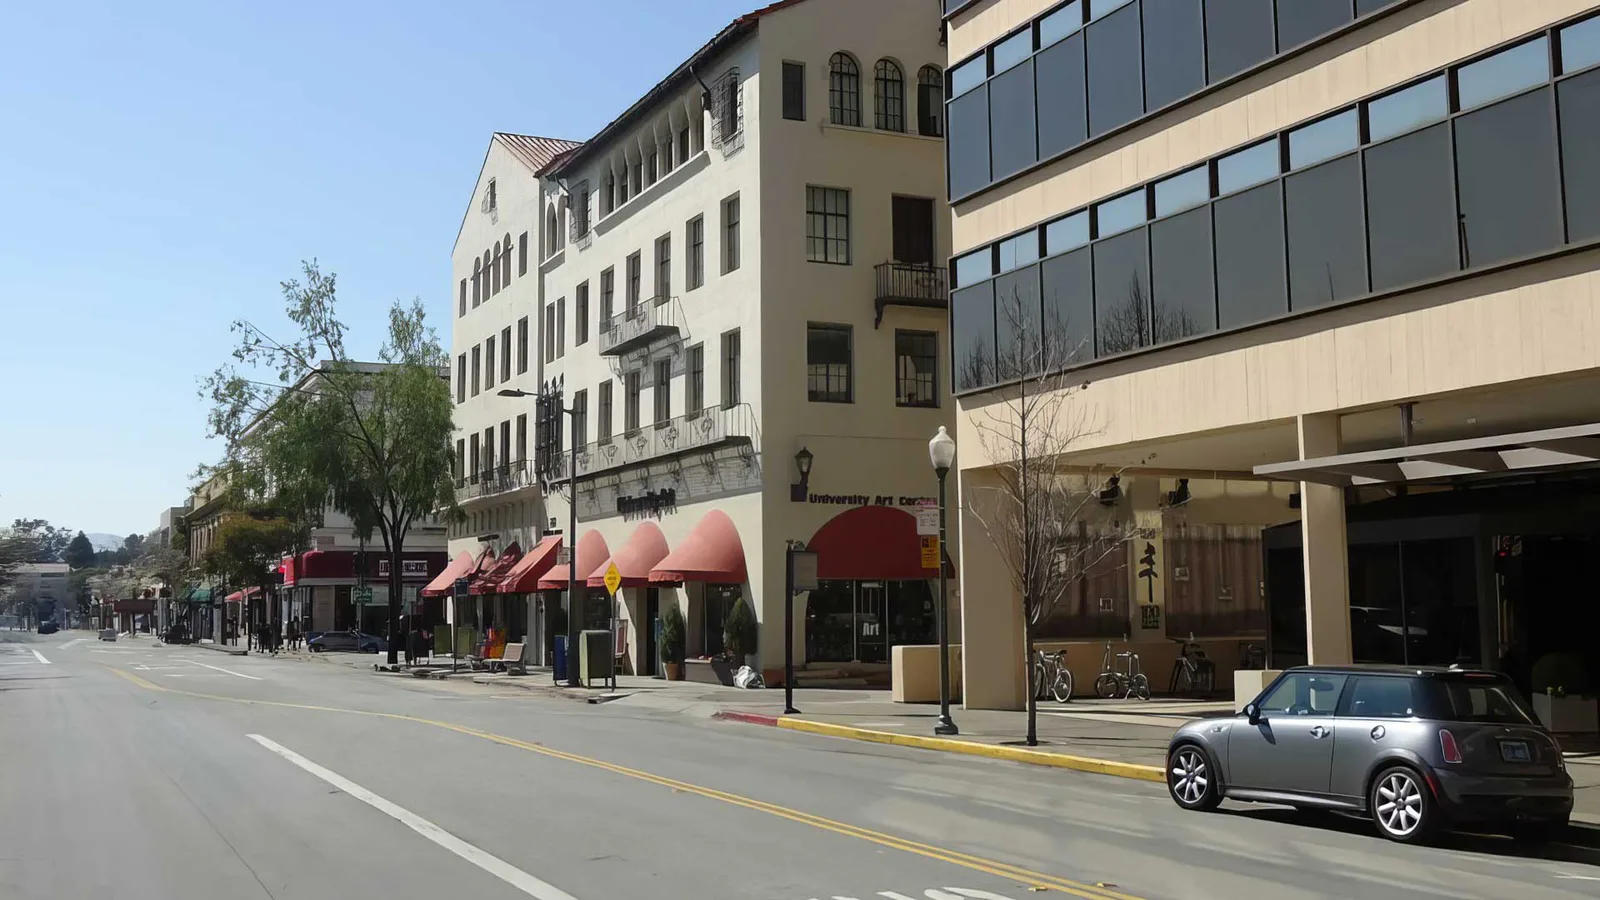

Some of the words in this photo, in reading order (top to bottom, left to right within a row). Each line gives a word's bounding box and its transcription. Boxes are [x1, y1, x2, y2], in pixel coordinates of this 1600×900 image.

[809, 493, 870, 506] University
[875, 495, 894, 506] Art
[862, 622, 880, 636] Art
